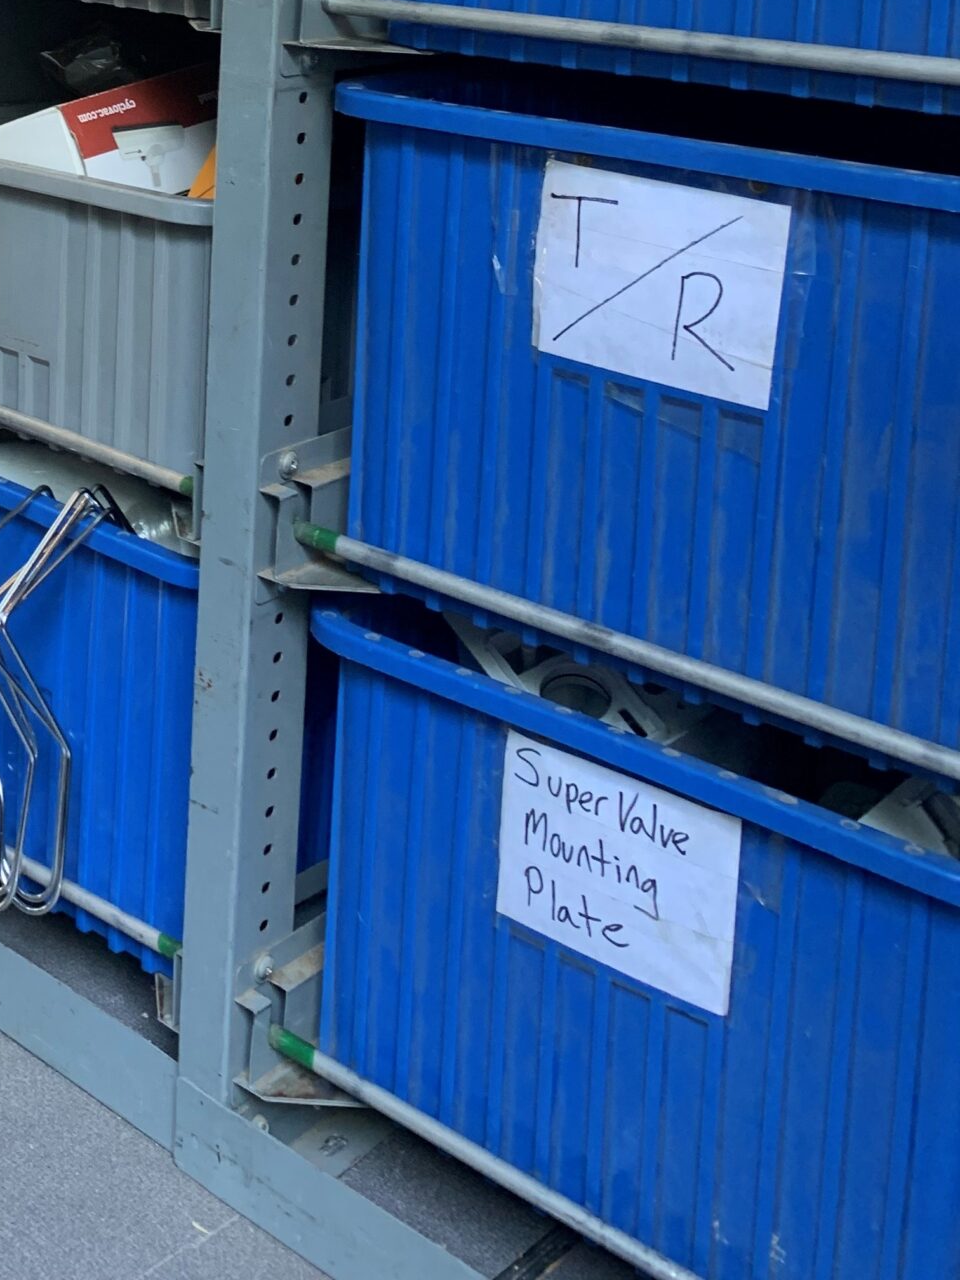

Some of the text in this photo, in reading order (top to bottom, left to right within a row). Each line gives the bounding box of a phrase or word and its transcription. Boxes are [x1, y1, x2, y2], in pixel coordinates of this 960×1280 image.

[77, 98, 137, 124] cyclovac.com
[524, 807, 661, 921] Mounting
[524, 866, 630, 948] Plate
